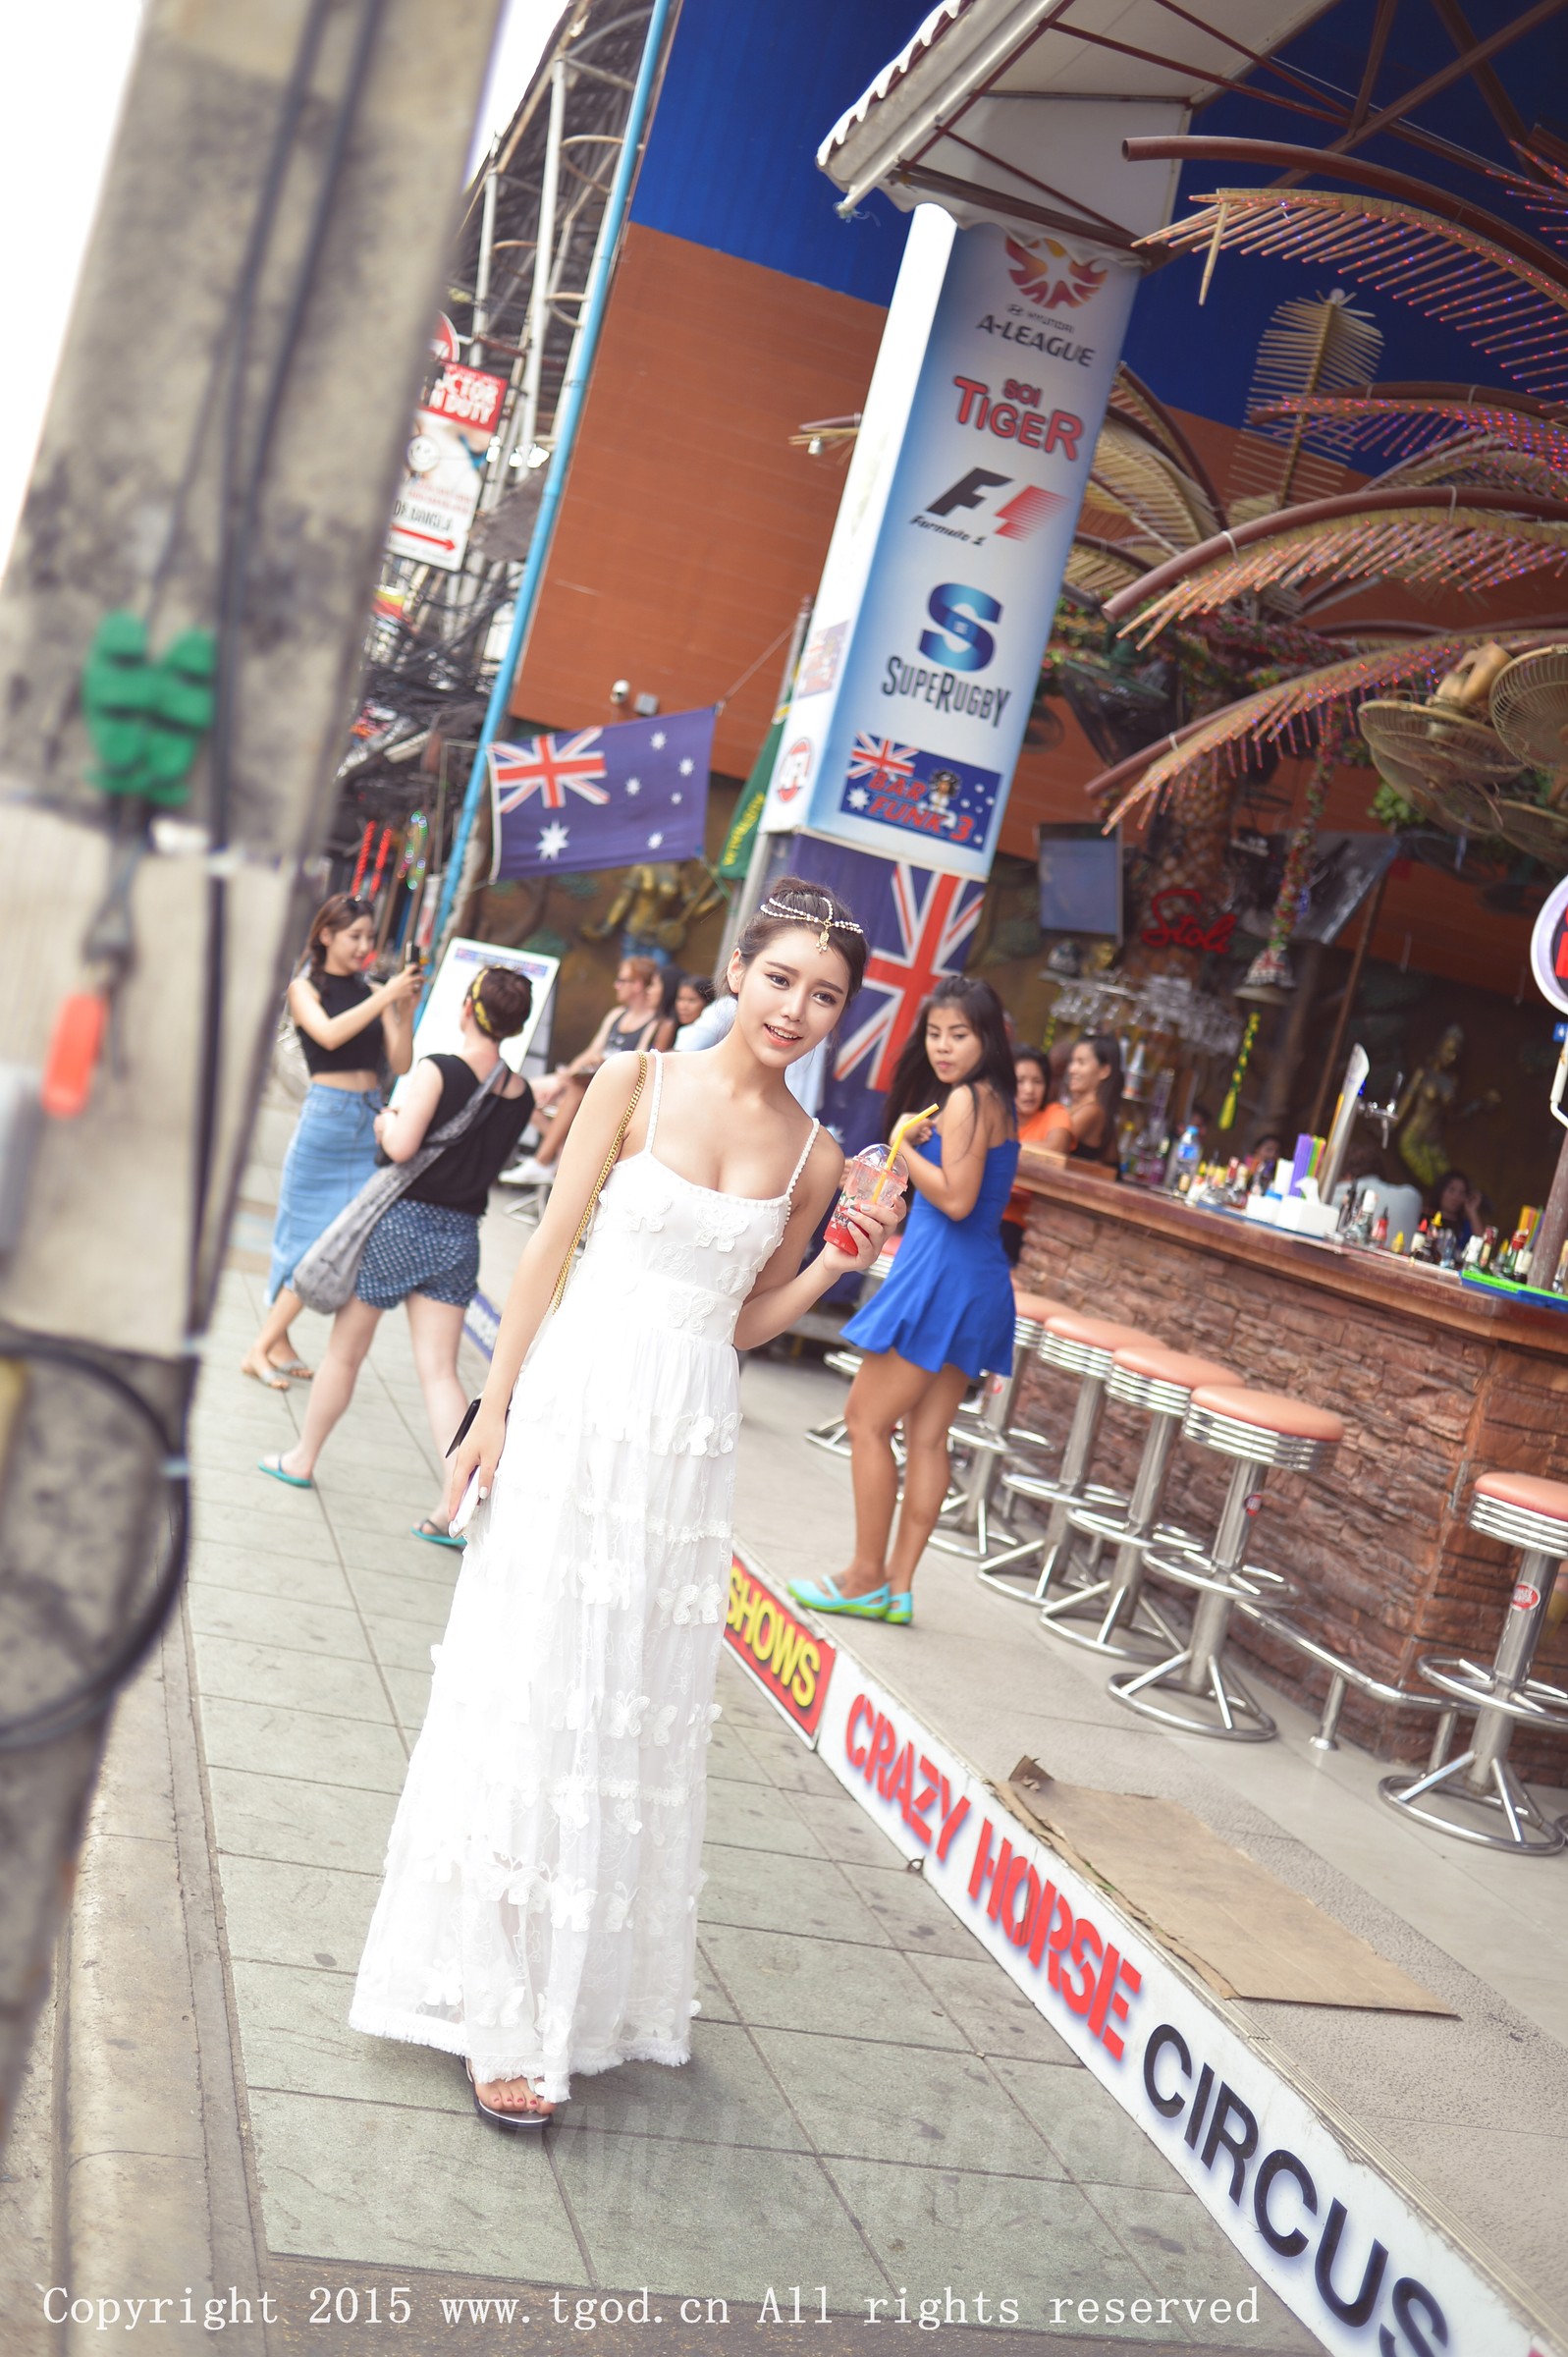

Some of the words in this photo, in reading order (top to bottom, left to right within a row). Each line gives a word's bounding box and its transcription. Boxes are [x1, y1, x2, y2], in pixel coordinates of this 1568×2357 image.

[975, 313, 1096, 368] A-LEAGUE
[952, 375, 1084, 462] TIGER
[868, 770, 928, 802] BAR
[868, 795, 949, 835] FUNK
[948, 814, 975, 843] 3
[727, 1566, 821, 1708] SHOWS
[845, 1693, 971, 1863] CRAZY
[967, 1817, 1142, 2062] HORSE
[1143, 2023, 1448, 2357] CIRCUS
